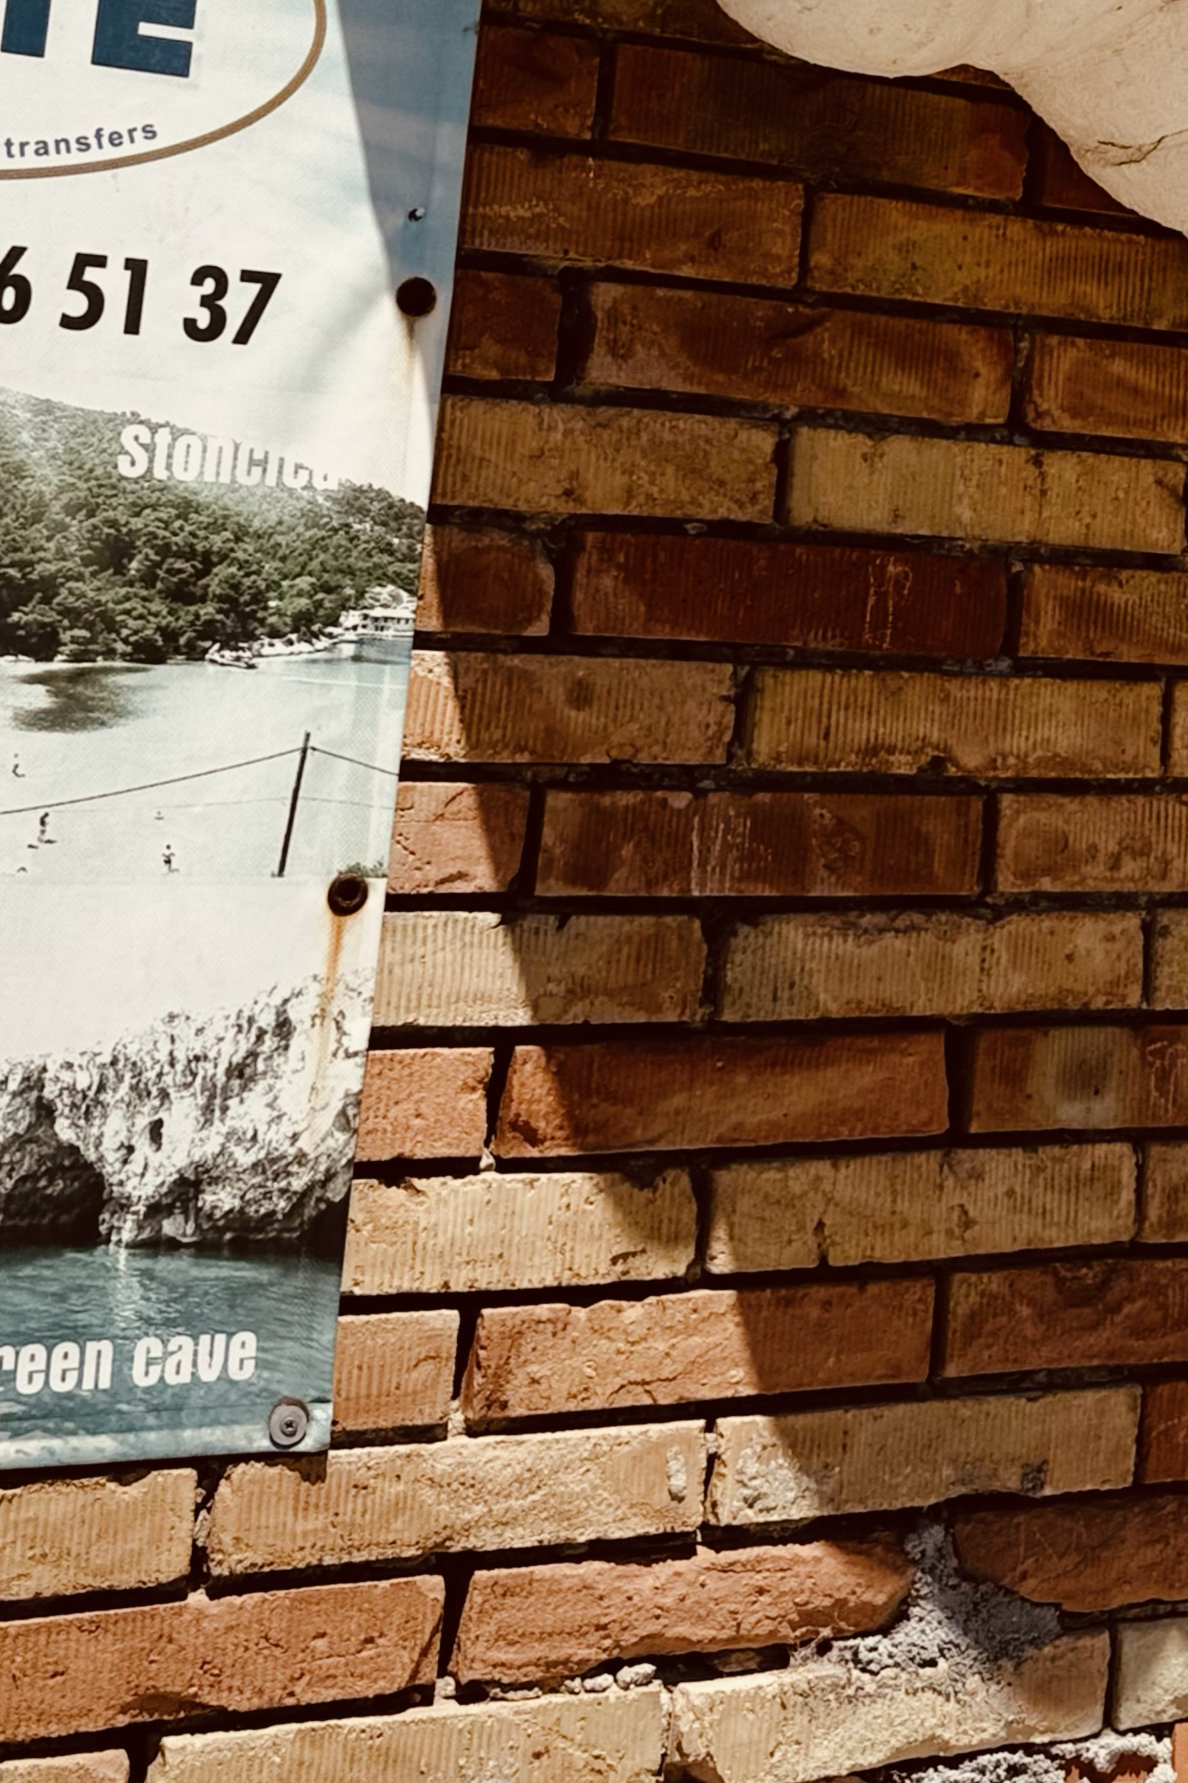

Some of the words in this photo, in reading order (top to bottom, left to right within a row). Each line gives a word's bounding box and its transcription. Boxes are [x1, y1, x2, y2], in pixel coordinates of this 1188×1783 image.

[4, 123, 158, 159] transfers
[0, 245, 32, 325] 6
[58, 252, 149, 336] 51
[182, 264, 283, 346] 37
[132, 1331, 258, 1387] cave
